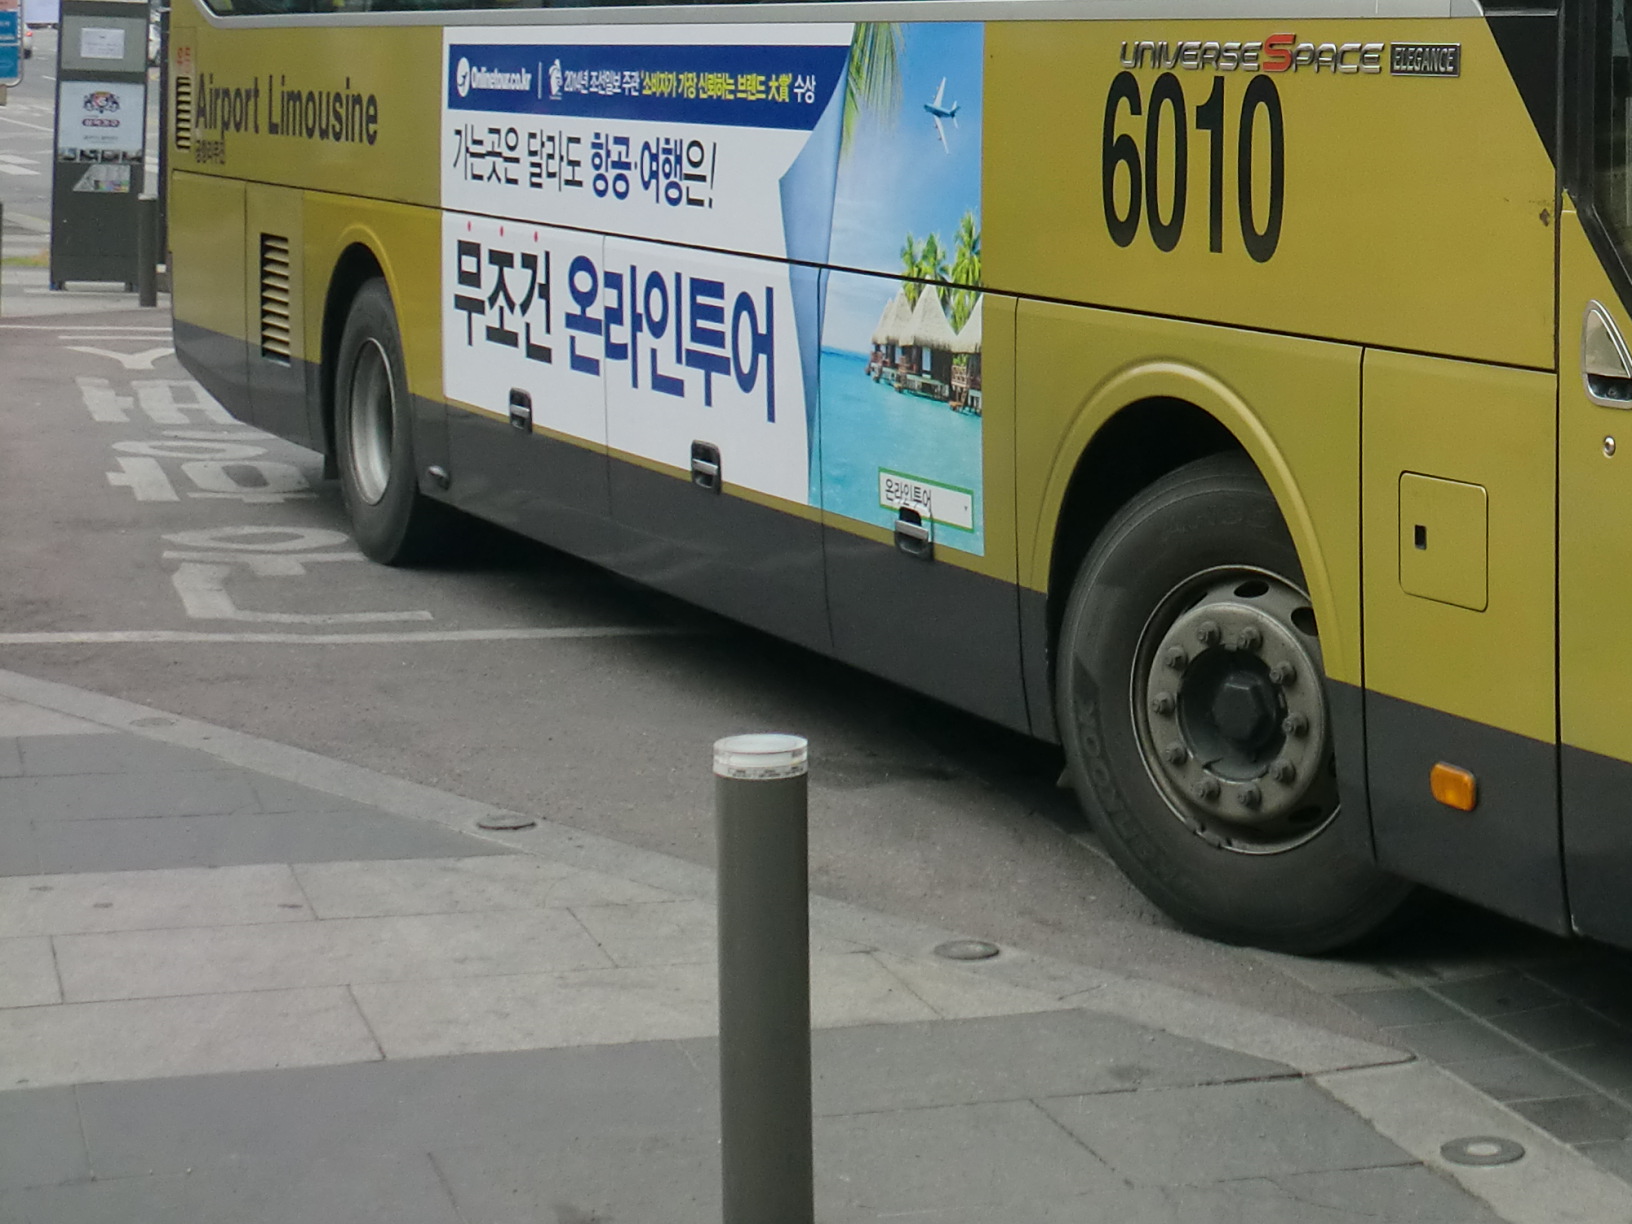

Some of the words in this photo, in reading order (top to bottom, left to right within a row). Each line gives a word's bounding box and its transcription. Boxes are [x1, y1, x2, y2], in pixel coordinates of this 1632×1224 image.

[590, 69, 621, 95] 조선일보
[622, 70, 639, 96] 주관
[678, 72, 697, 99] 가장
[698, 72, 735, 100] 신뢰하는
[736, 73, 768, 101] 브랜드
[793, 74, 816, 104] 수상
[1120, 40, 1262, 73] UNIVERSE
[1261, 32, 1386, 74] SPACE
[1392, 46, 1457, 74] ELEGANCE
[195, 73, 259, 139] Airport
[268, 74, 378, 146] Limousine
[527, 130, 584, 192] 달라도
[1102, 71, 1284, 263] 6010
[454, 239, 552, 365] 무조건
[565, 255, 776, 423] 온라인투어
